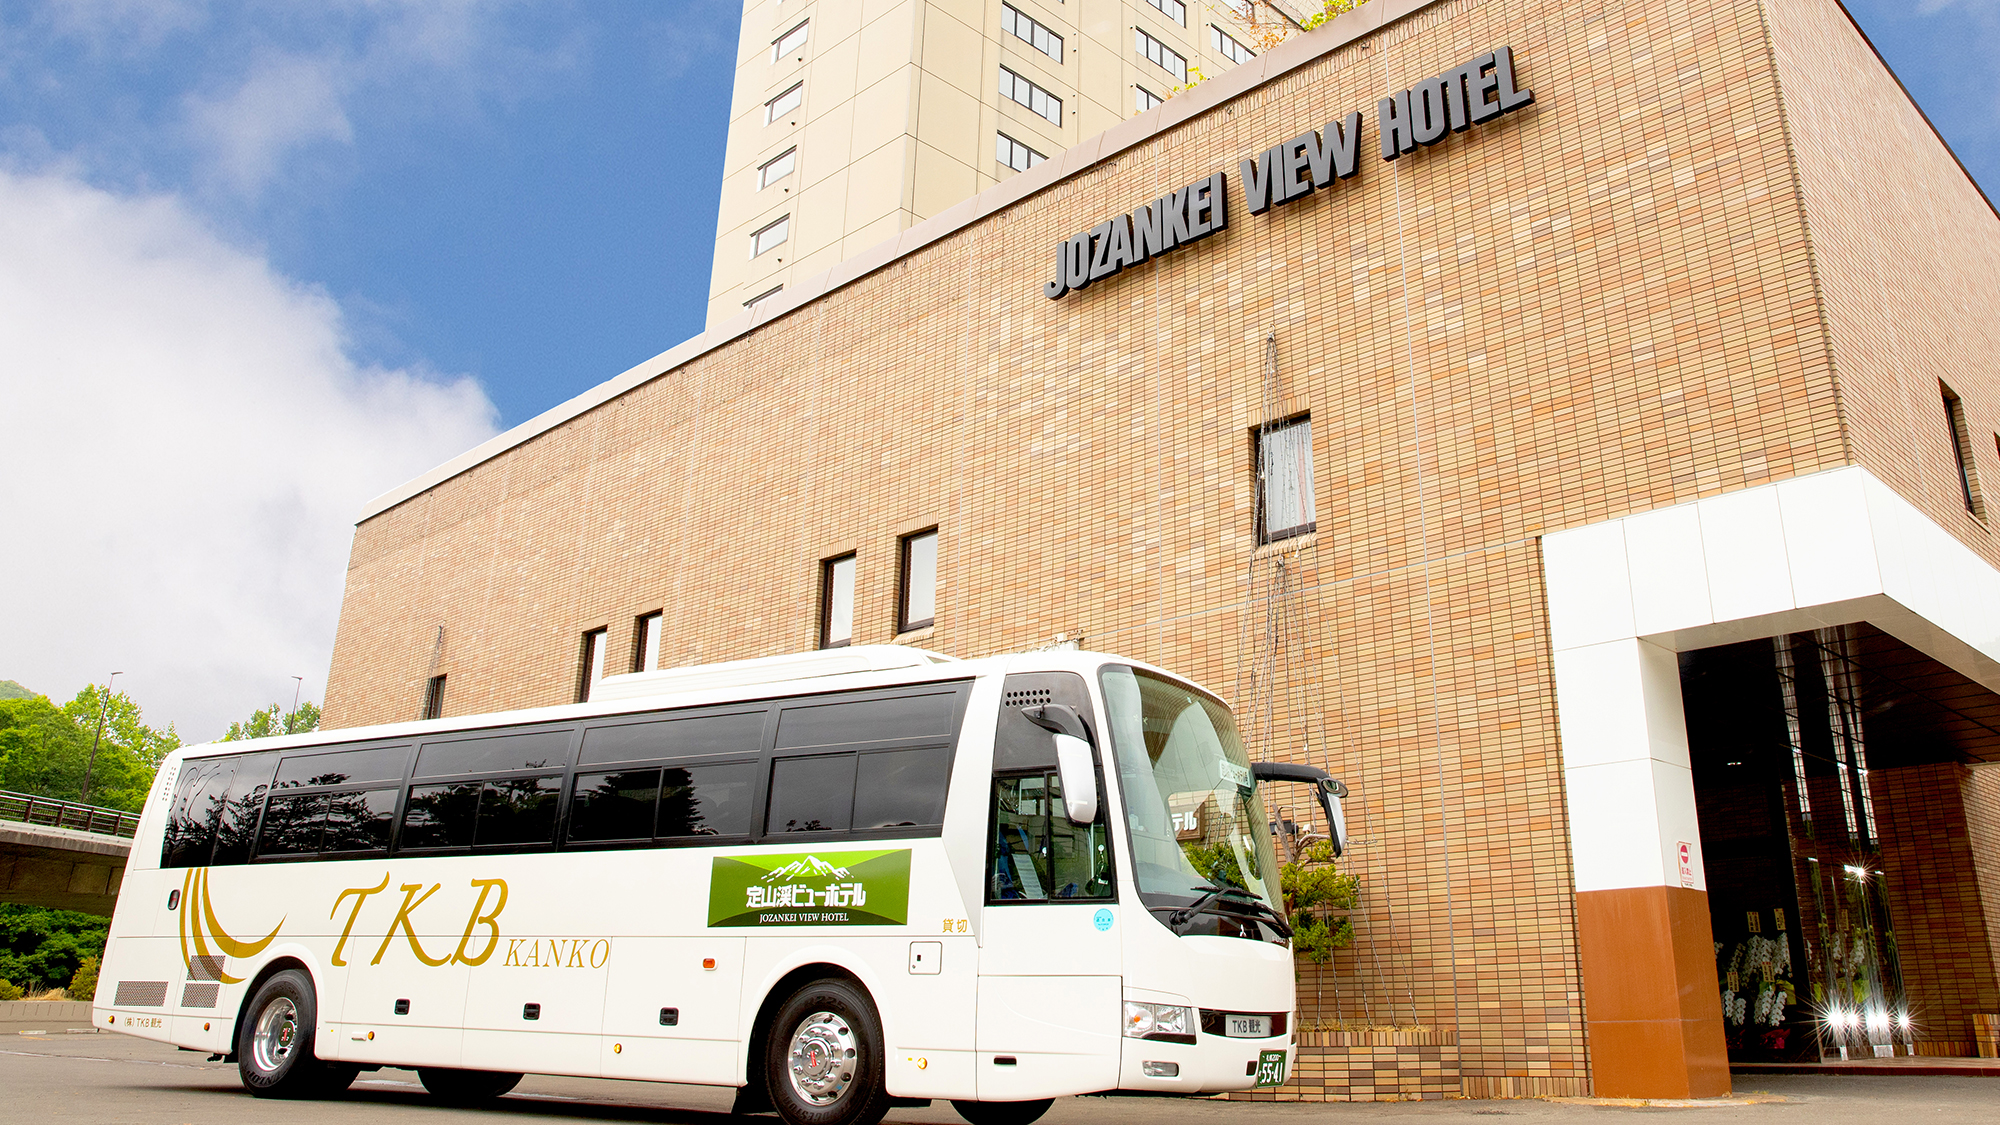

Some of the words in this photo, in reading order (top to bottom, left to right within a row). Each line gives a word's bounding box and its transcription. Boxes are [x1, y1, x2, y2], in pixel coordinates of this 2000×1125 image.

[1043, 171, 1228, 300] JOZANKEI
[1239, 111, 1363, 216] VIEW
[1378, 45, 1536, 162] HOTEL
[746, 883, 866, 908] 定山渓ビューホテル
[329, 871, 509, 967] TKB
[502, 938, 610, 969] KANKO
[759, 914, 797, 923] JOZANKEI
[800, 914, 819, 922] VIEW
[821, 913, 849, 921] HOTEL
[942, 918, 968, 933] 貸切
[137, 1018, 150, 1027] TKB
[1232, 1020, 1247, 1033] TKB
[1249, 1019, 1261, 1033] 観光
